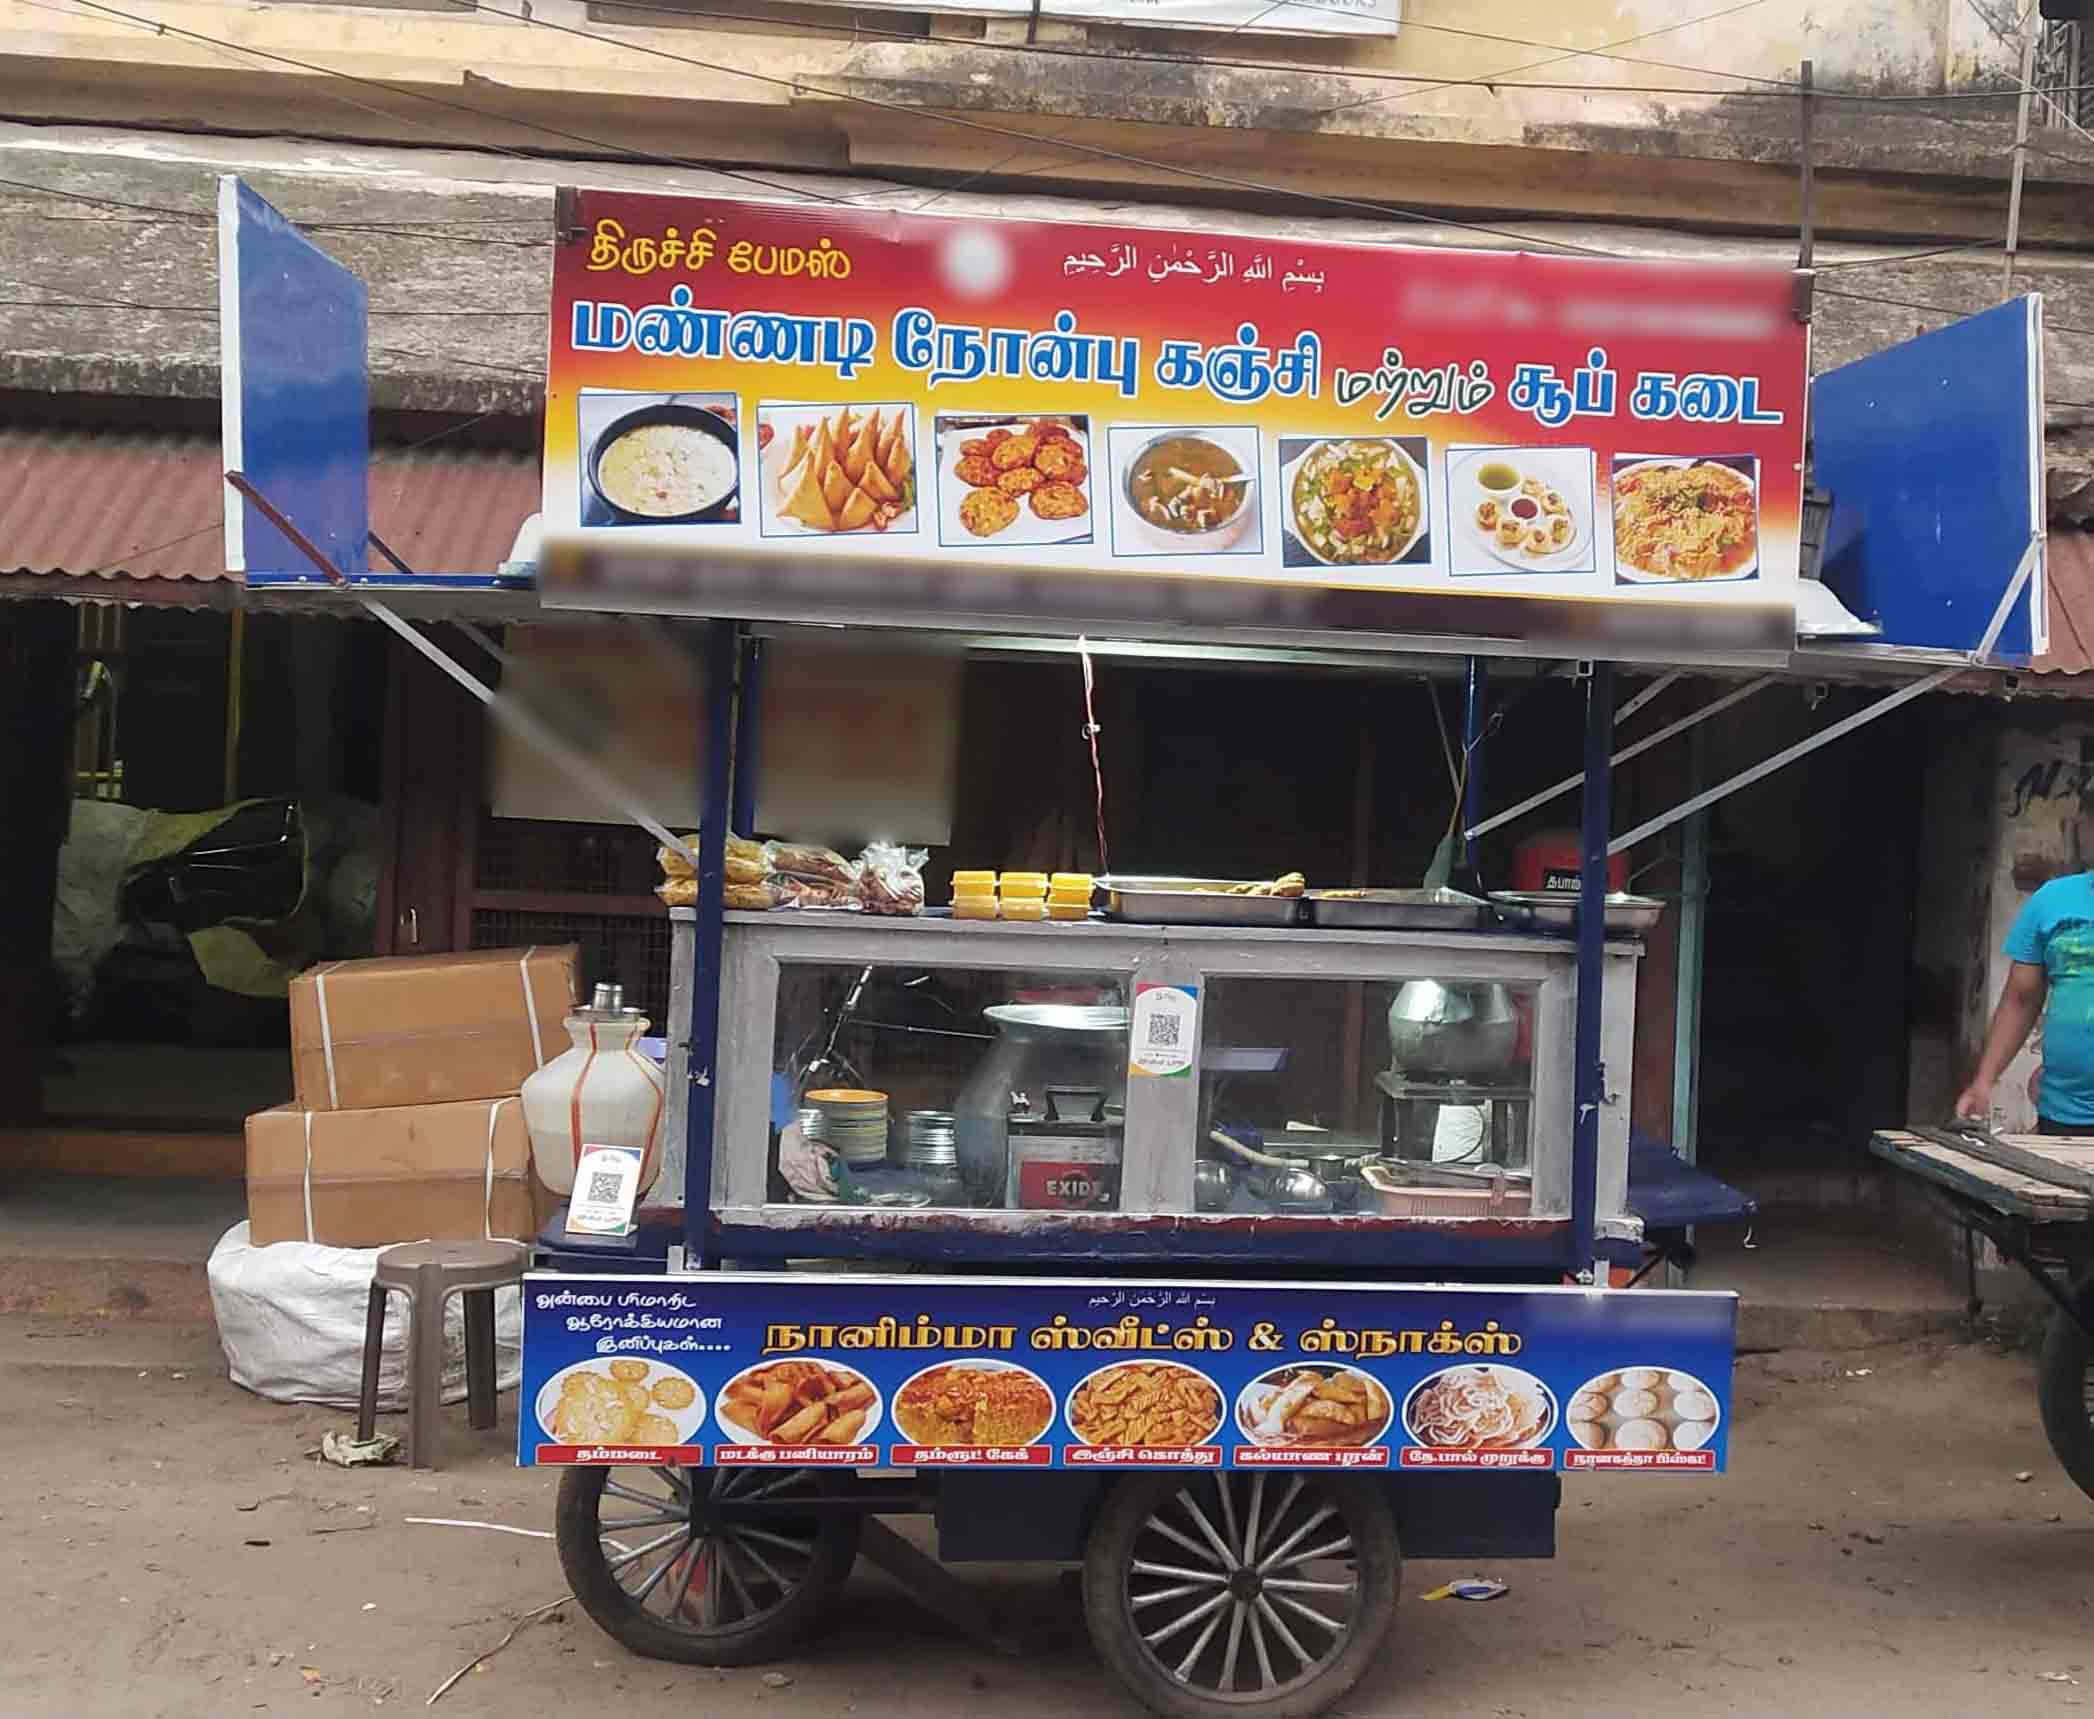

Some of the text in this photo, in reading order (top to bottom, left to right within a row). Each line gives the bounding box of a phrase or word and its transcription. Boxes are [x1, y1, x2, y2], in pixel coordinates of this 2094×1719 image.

[588, 219, 851, 280] திருச்சி பேமஸ்
[571, 285, 1784, 425] மண்ணடி நோன்பு கஞ்சி மற்றும் சூப் கடை
[535, 1290, 697, 1310] அன்பை பரிமாறிட
[564, 1312, 723, 1331] ஆரோக்கியமான
[761, 1314, 1523, 1361] நானிம்மா ஸ்வீட்ஸ் & ஸ்நாக்ஸ்
[1071, 1447, 1134, 1463] இஞ்சி
